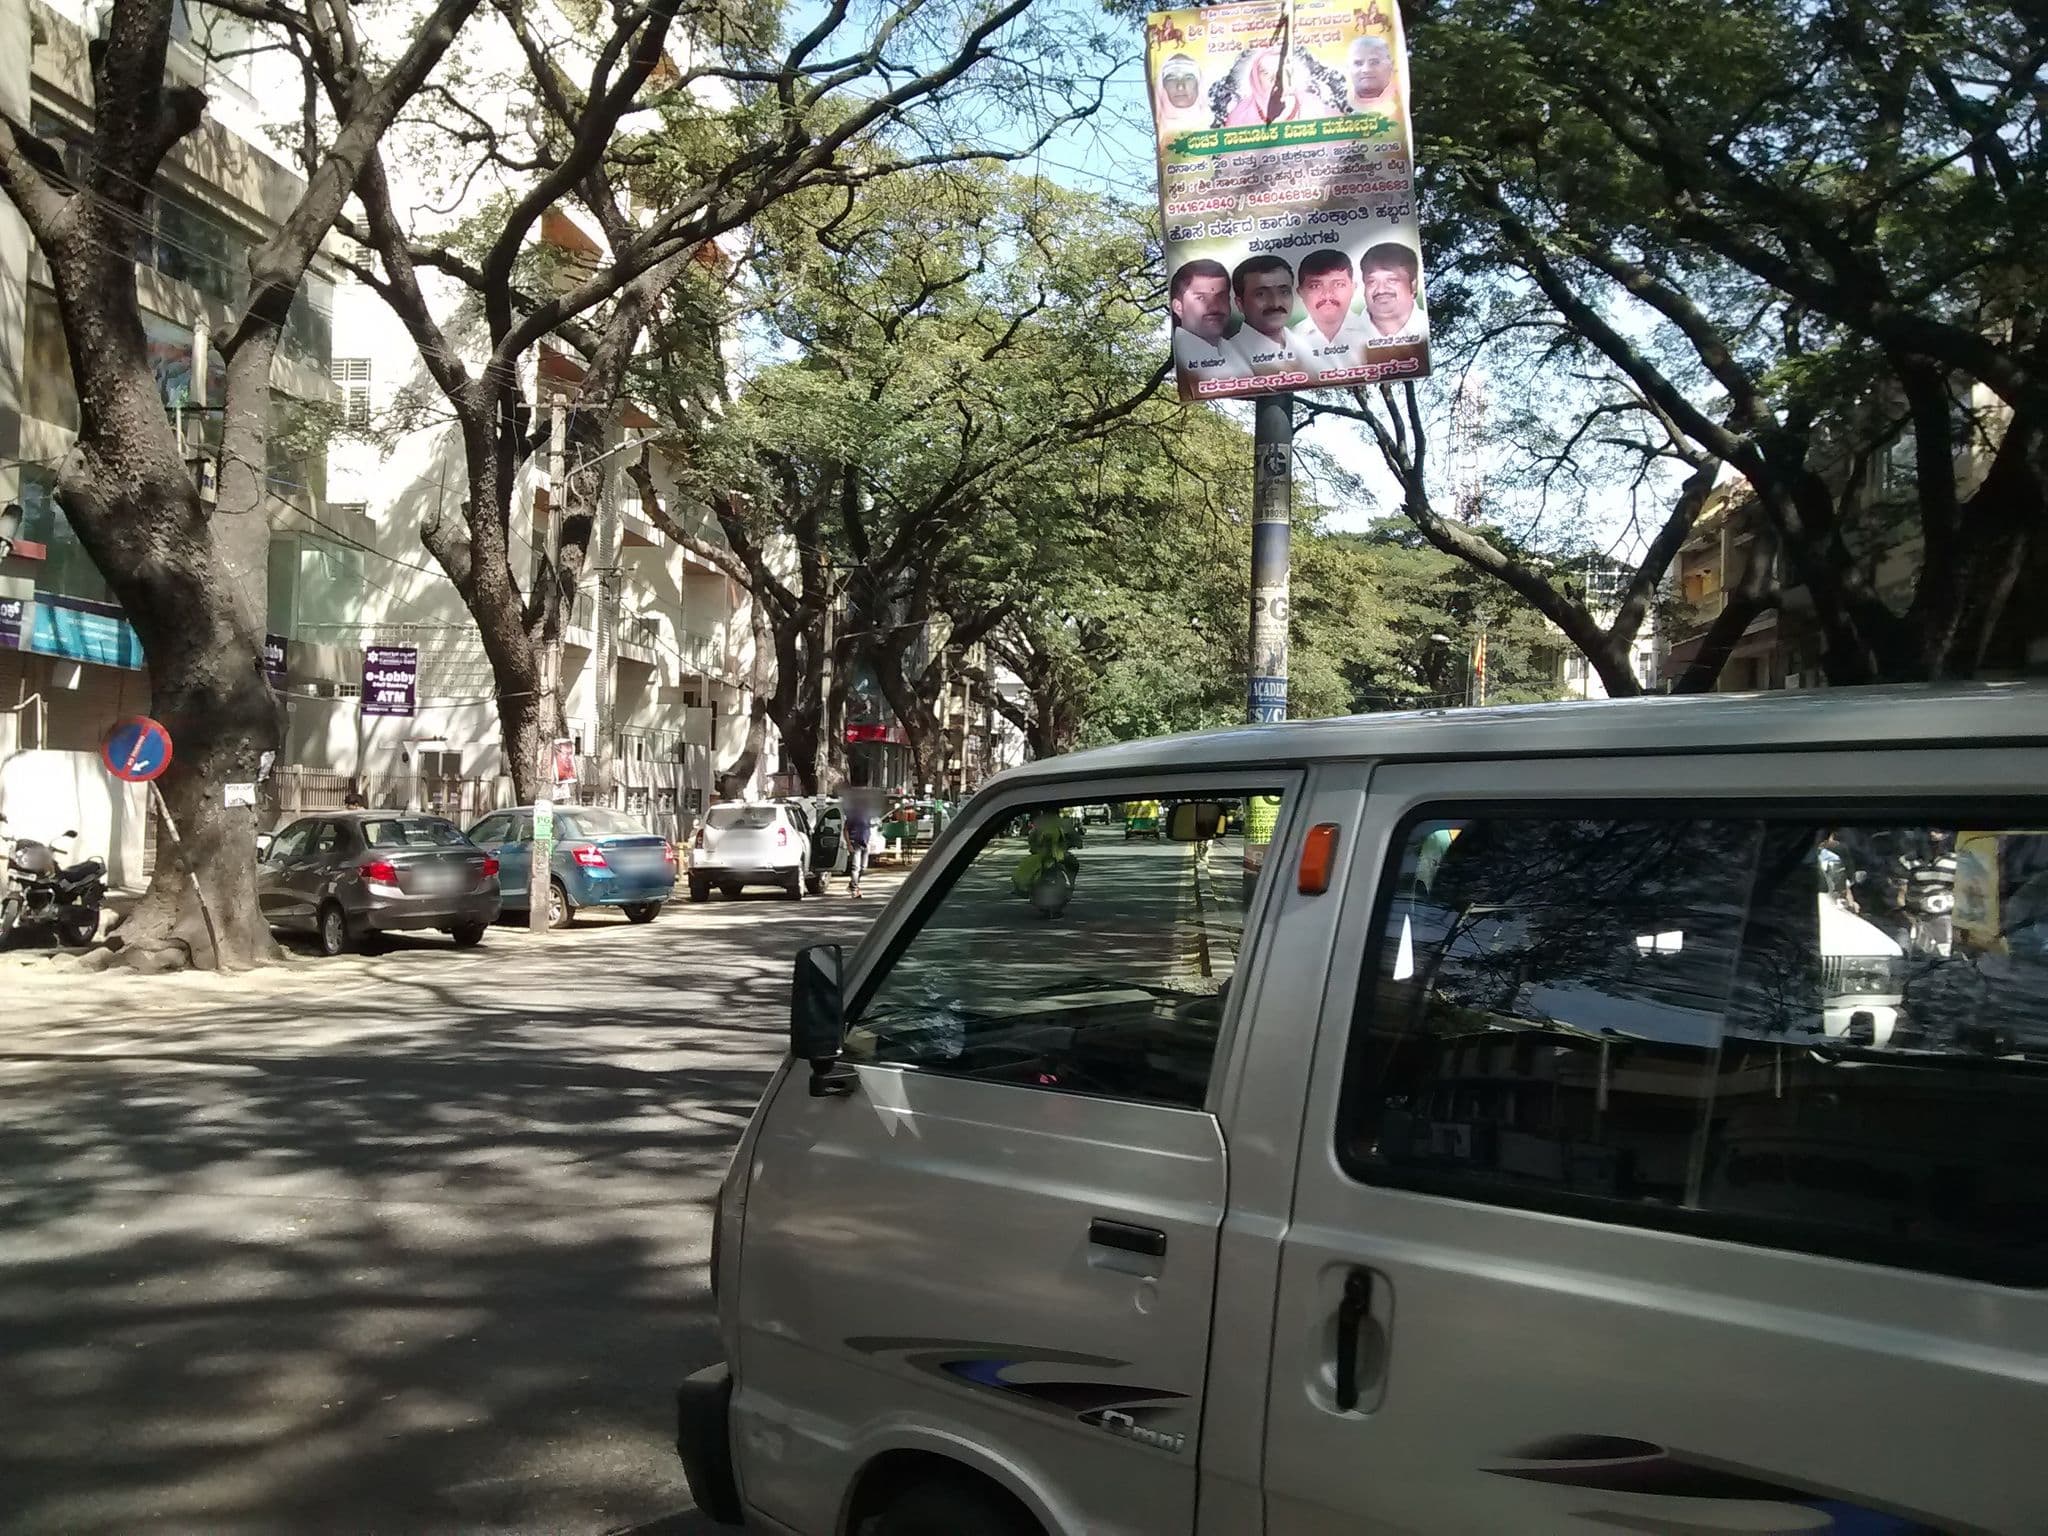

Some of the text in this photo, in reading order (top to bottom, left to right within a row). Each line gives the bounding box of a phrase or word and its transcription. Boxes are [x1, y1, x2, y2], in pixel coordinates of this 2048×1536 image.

[1262, 154, 1276, 164] 29
[1169, 202, 1411, 241] ಹೊಸ ವರ್ಷದ ಹಾಗೂ ಸಂಕ್ರಾಂತಿ ಹಬ್ಬದ
[1248, 229, 1340, 253] ಶುಭಾಶಯಗಳು
[1319, 357, 1418, 381] ಸುಸ್ವಾಗತ
[366, 670, 414, 685] e-Lobby
[376, 690, 406, 703] ATM
[1101, 1410, 1185, 1454] Omni
